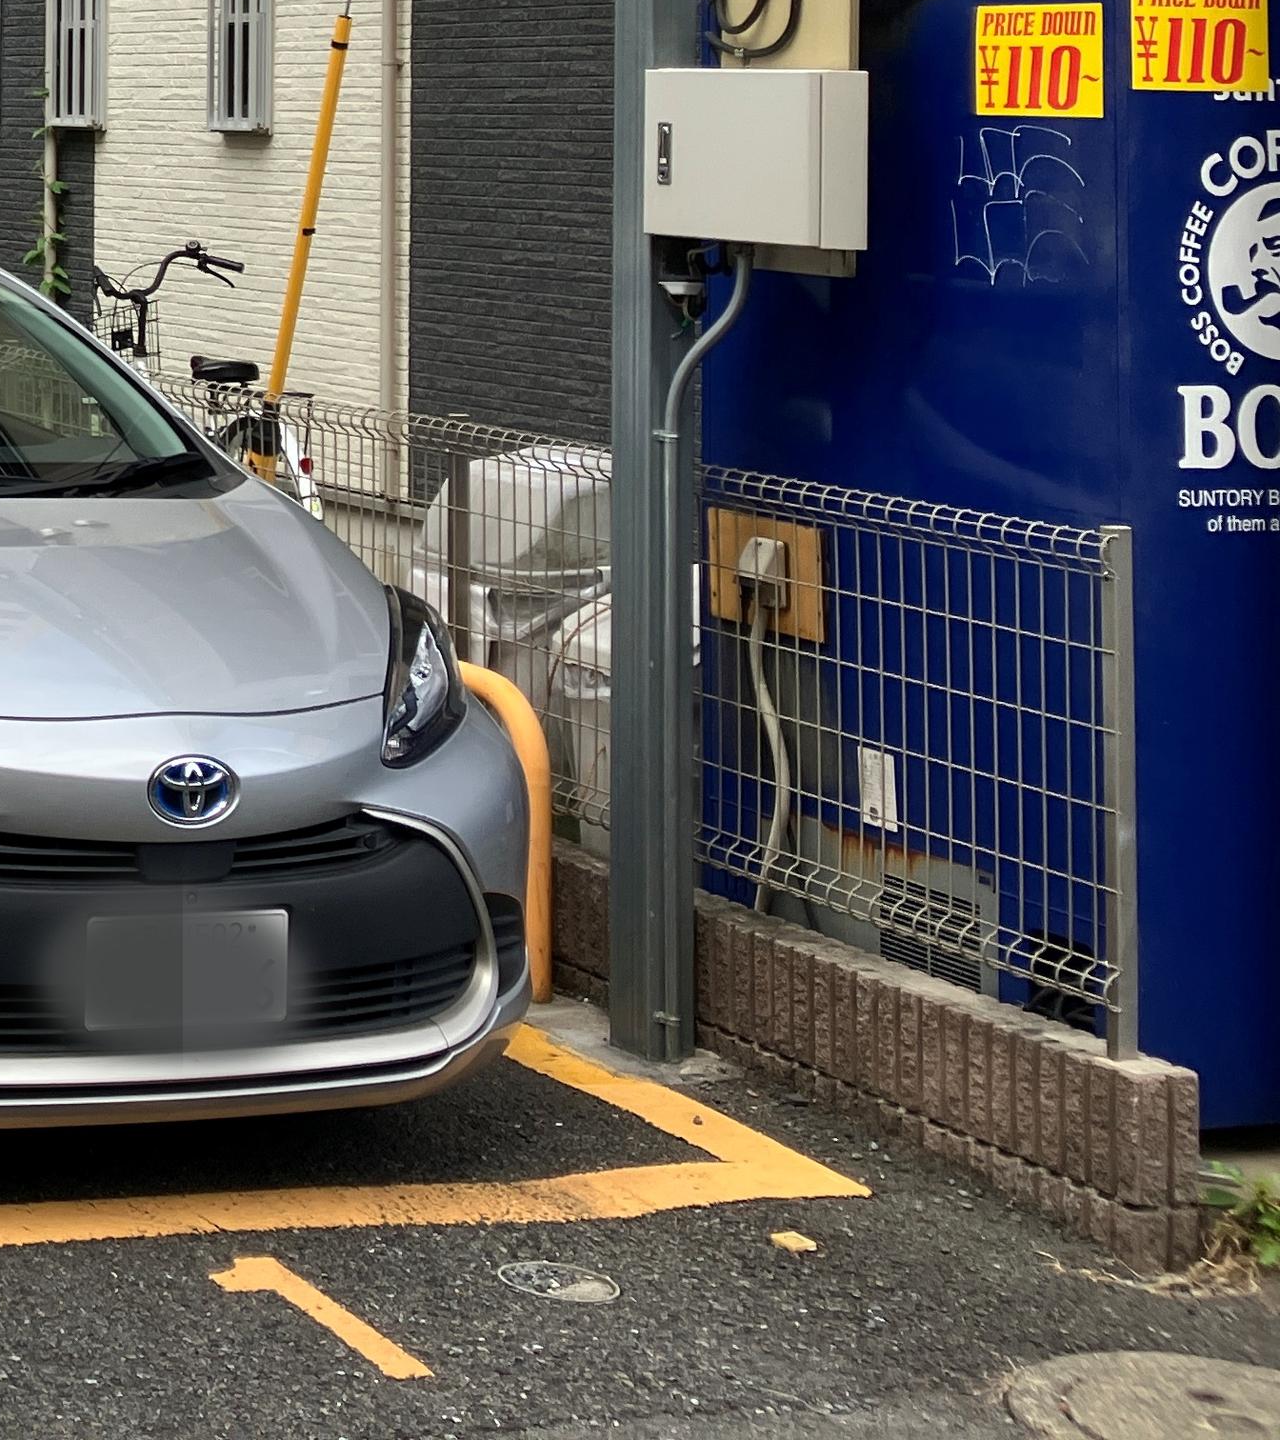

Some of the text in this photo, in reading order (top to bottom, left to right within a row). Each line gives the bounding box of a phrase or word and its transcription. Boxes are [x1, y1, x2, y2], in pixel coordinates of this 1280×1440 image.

[982, 11, 1096, 36] PRICE DOWN
[1179, 201, 1245, 376] BOSS COFFEE
[1178, 489, 1264, 507] SUNTORY
[1207, 515, 1223, 532] of
[1227, 515, 1265, 532] them
